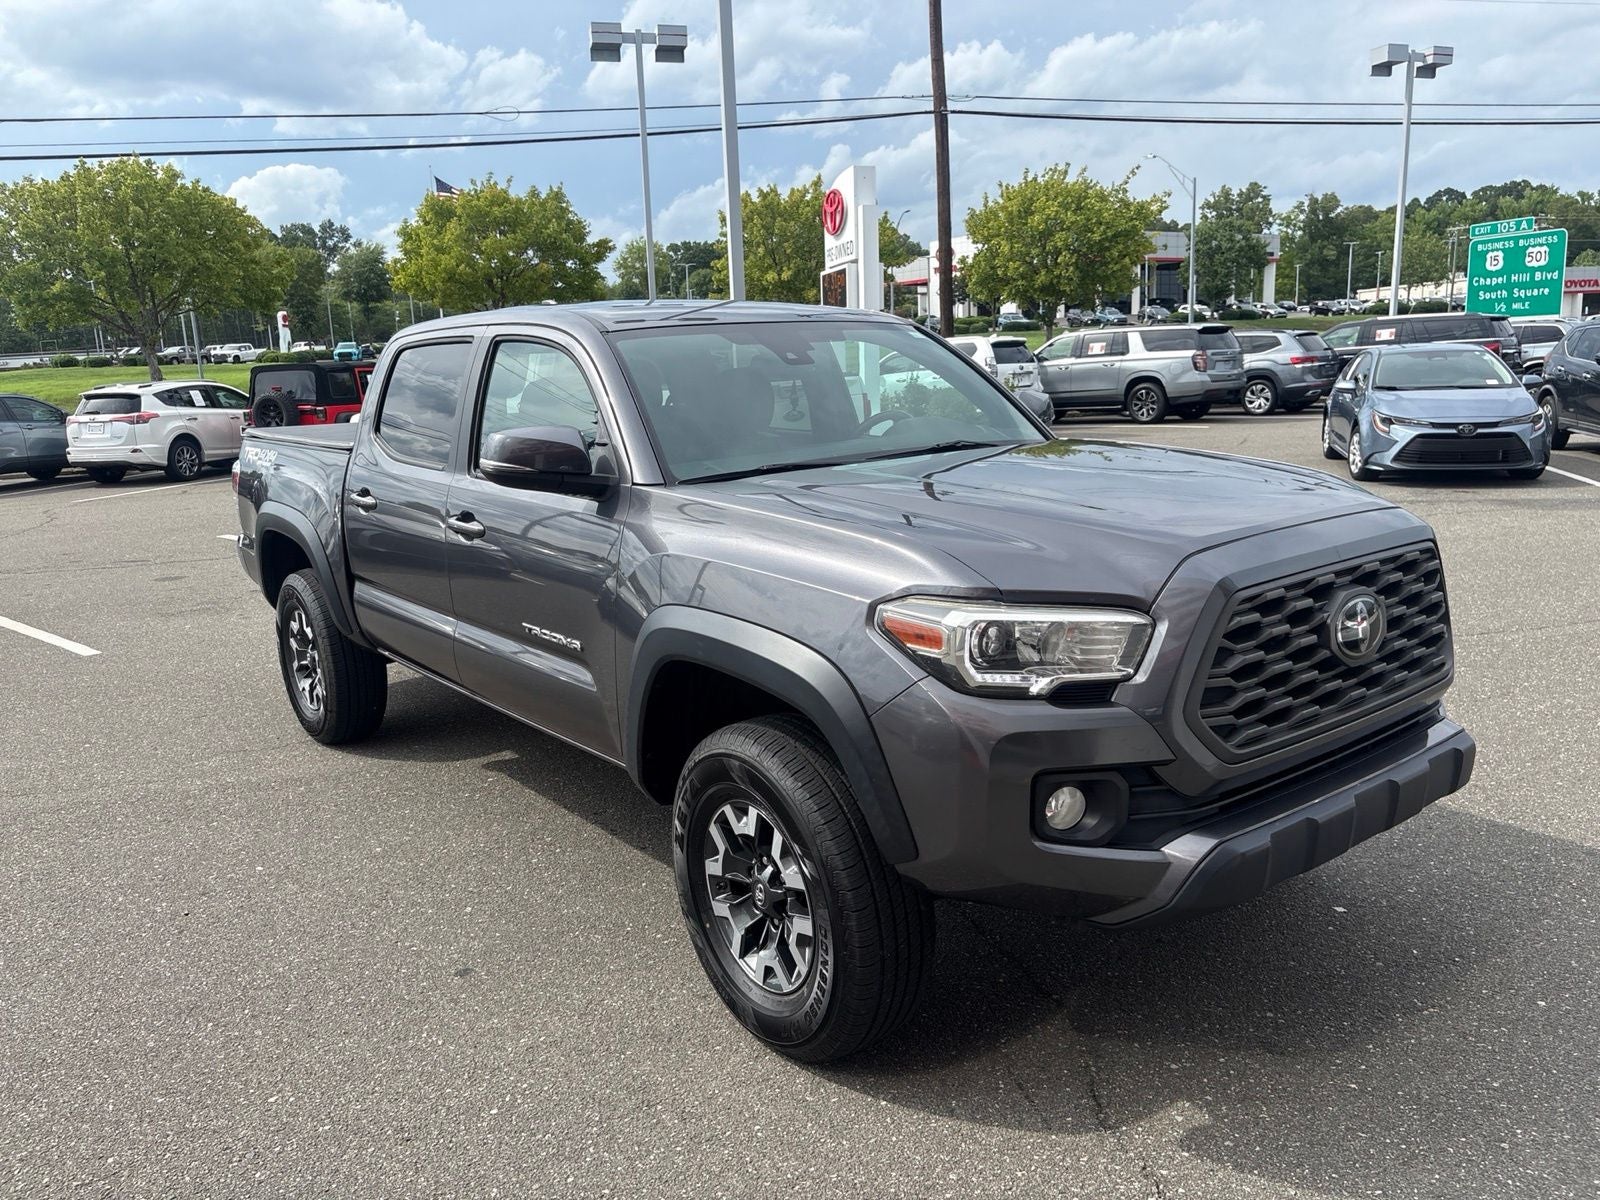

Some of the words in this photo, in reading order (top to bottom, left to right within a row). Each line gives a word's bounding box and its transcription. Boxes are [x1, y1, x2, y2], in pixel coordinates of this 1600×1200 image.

[1475, 225, 1491, 235] EXIT
[1497, 221, 1516, 233] 105
[1520, 220, 1529, 231] A
[1477, 240, 1514, 251] BUSINESS
[1519, 235, 1558, 246] BUSINESS
[1489, 255, 1500, 267] 15
[1527, 250, 1547, 263] 501
[1473, 275, 1506, 287] Chapel
[1511, 273, 1530, 283] Hill
[1535, 270, 1559, 281] Blvd
[1565, 279, 1600, 288] OYOTA
[1478, 288, 1508, 301] South
[1513, 287, 1550, 299] Square
[1512, 302, 1530, 310] MILE
